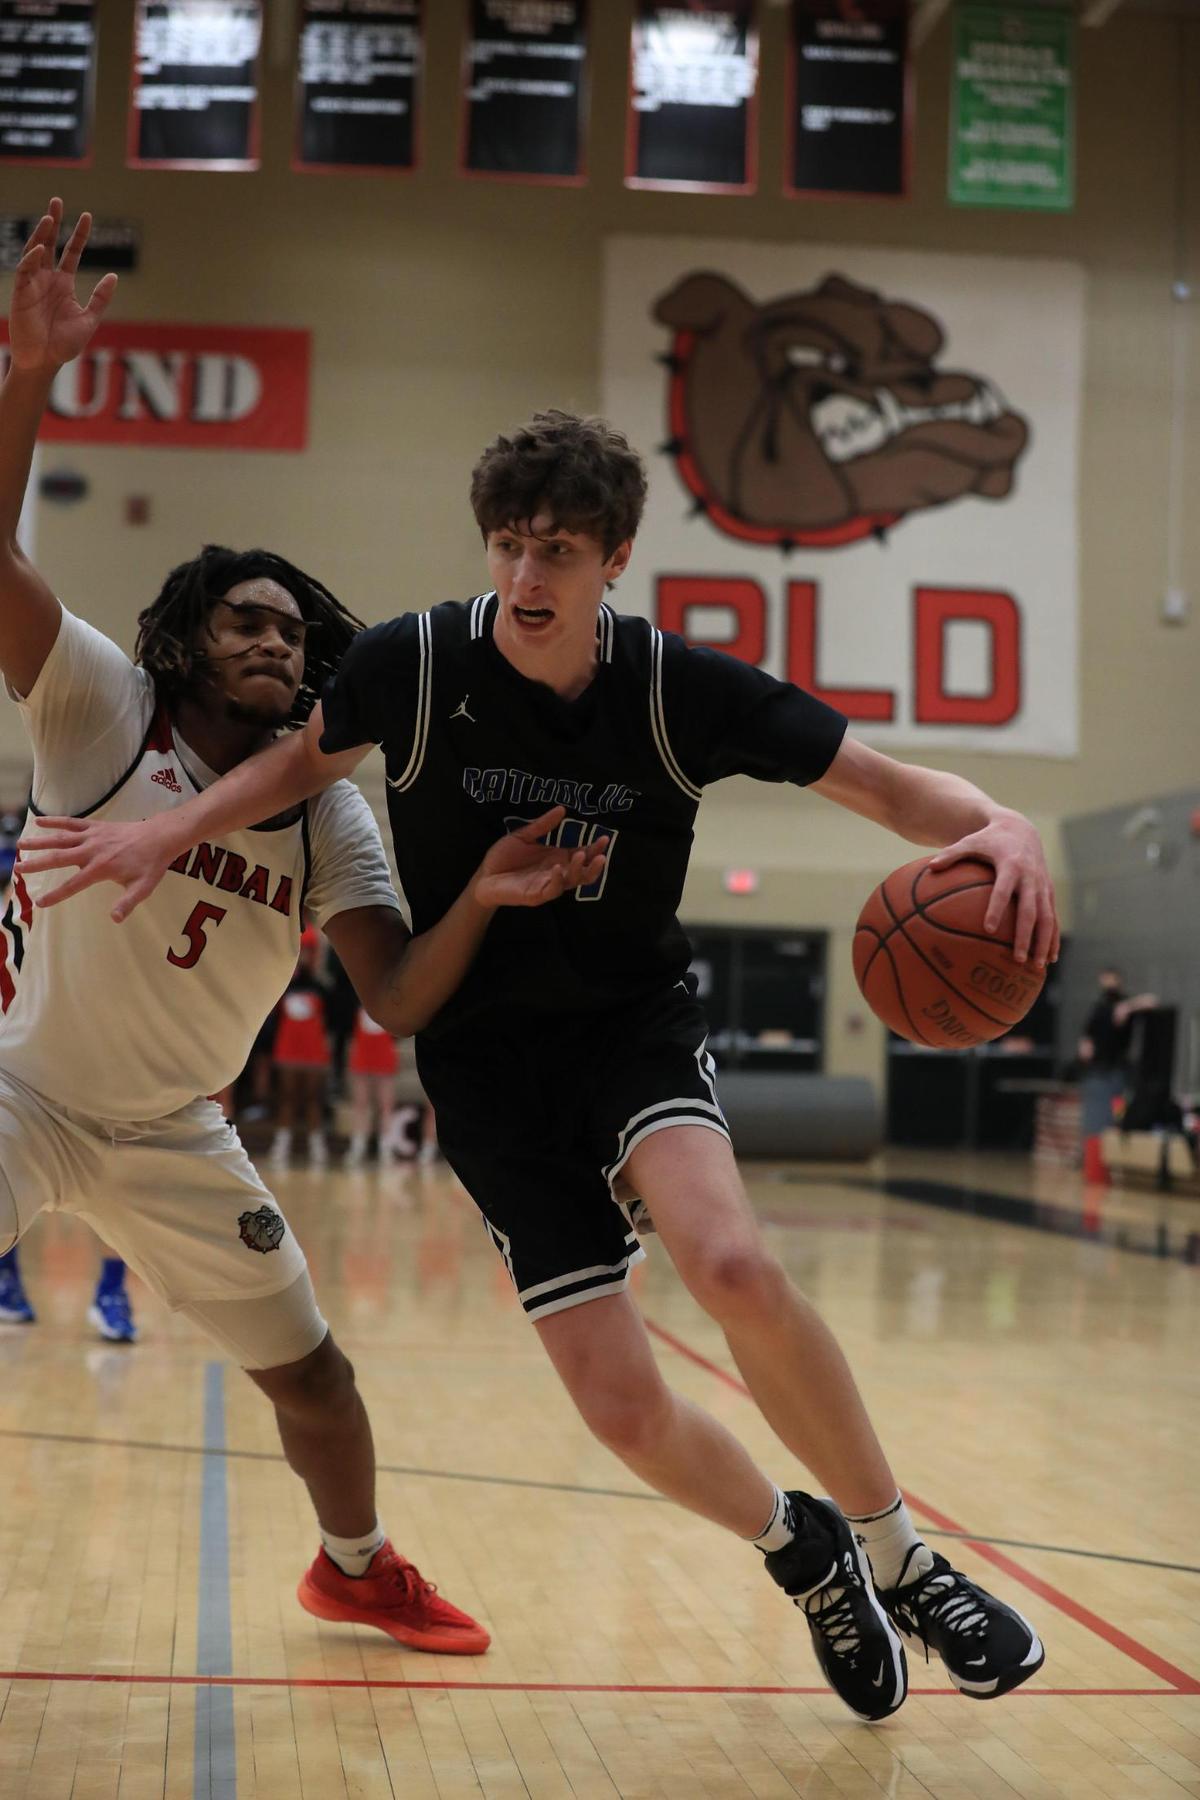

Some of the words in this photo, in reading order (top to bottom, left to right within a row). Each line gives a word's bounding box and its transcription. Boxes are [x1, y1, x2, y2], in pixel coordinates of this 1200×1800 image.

[0, 345, 262, 423] UND
[151, 774, 182, 793] adidas
[462, 767, 641, 815] CATHOLIC
[166, 900, 227, 969] 5
